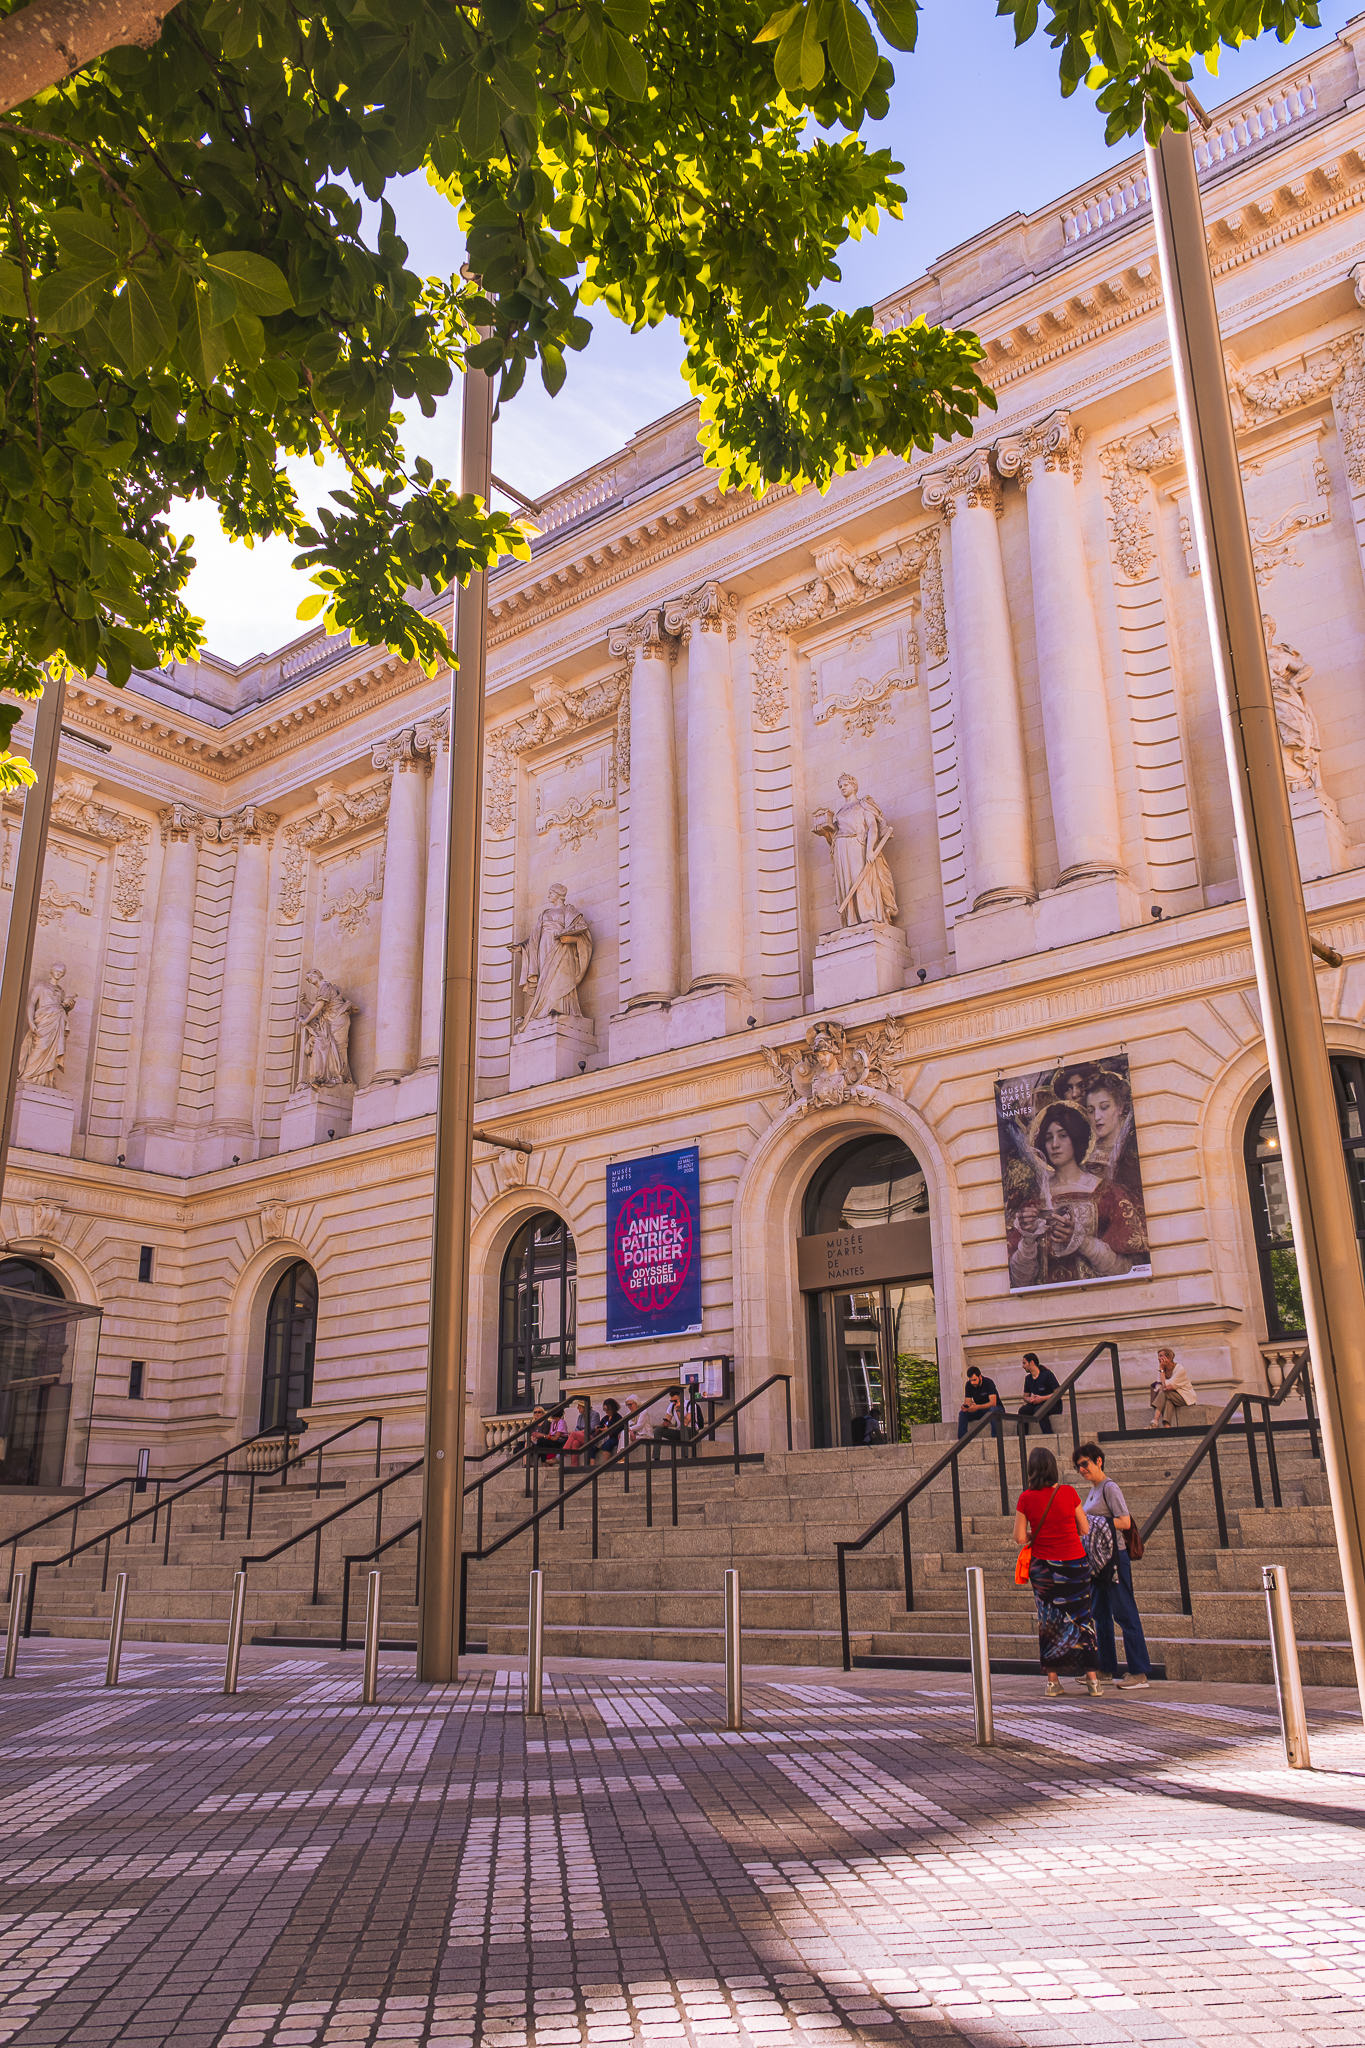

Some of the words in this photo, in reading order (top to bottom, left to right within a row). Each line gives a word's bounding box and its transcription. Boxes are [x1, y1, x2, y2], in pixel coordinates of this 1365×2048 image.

[1001, 1083, 1030, 1095] MUSÉE
[1001, 1092, 1031, 1103] D'ARTS
[1002, 1106, 1032, 1118] NANTES
[612, 1166, 632, 1176] MUSÉE
[612, 1173, 632, 1182] D'ARTS
[612, 1185, 632, 1194] NANTES
[628, 1214, 669, 1236] ANNE
[670, 1218, 677, 1228] &
[622, 1226, 685, 1252] PATRICK
[827, 1233, 863, 1249] MUSÉE
[623, 1243, 683, 1267] POIRIER
[827, 1245, 864, 1259] D'ARTS
[632, 1262, 674, 1279] ODYSSÉE
[827, 1259, 839, 1269] DE
[828, 1266, 865, 1280] NANTES
[630, 1278, 642, 1289] DE
[643, 1273, 677, 1287] L'OUBLI
